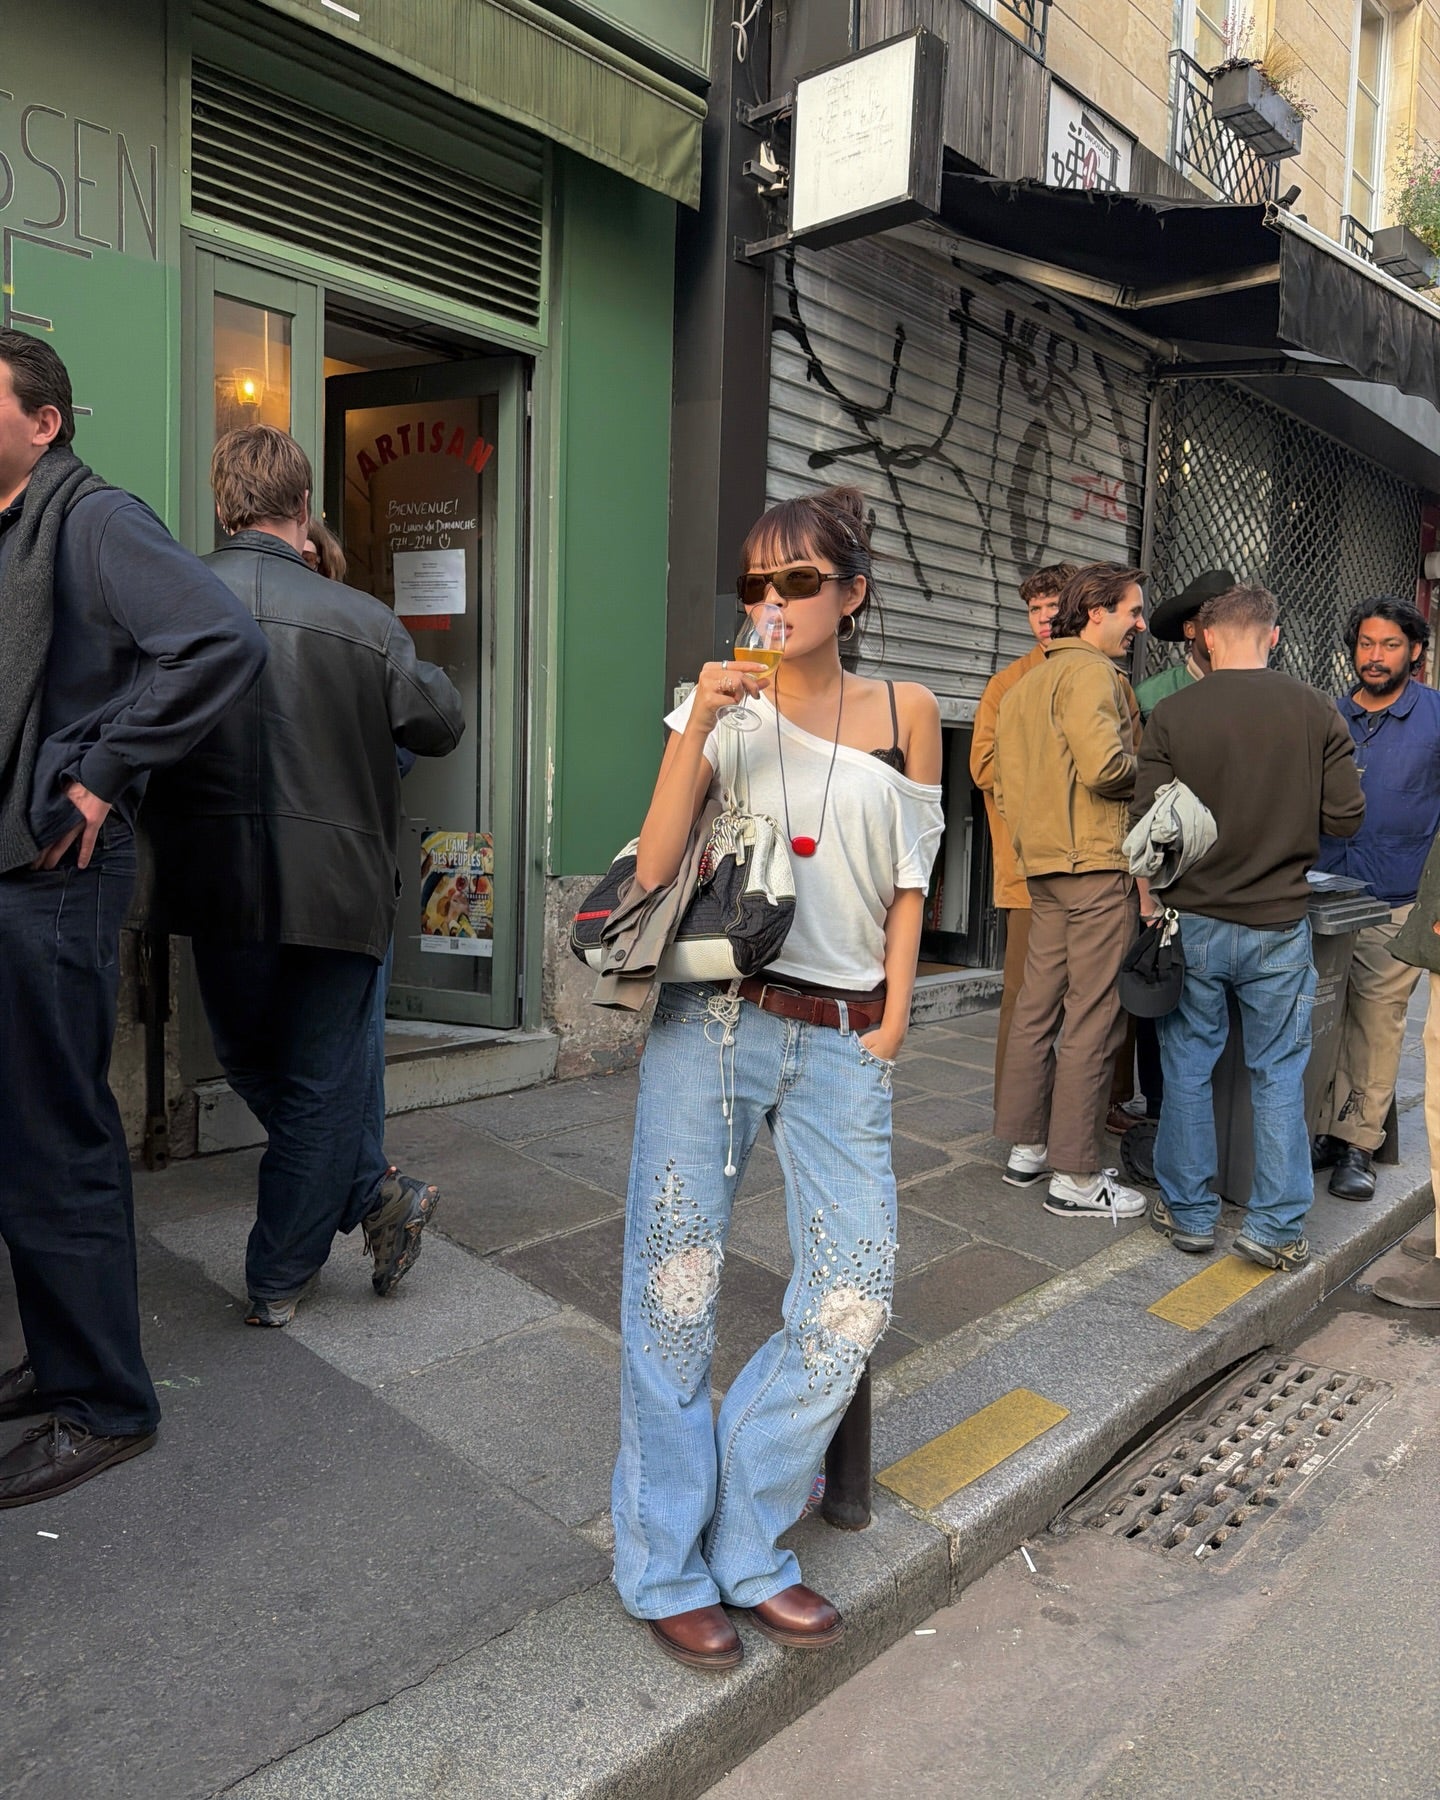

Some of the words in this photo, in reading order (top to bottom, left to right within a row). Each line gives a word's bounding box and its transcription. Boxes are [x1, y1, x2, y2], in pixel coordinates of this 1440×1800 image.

[0, 89, 158, 262] SEN
[357, 421, 494, 480] ARTISAN
[433, 851, 447, 865] DES
